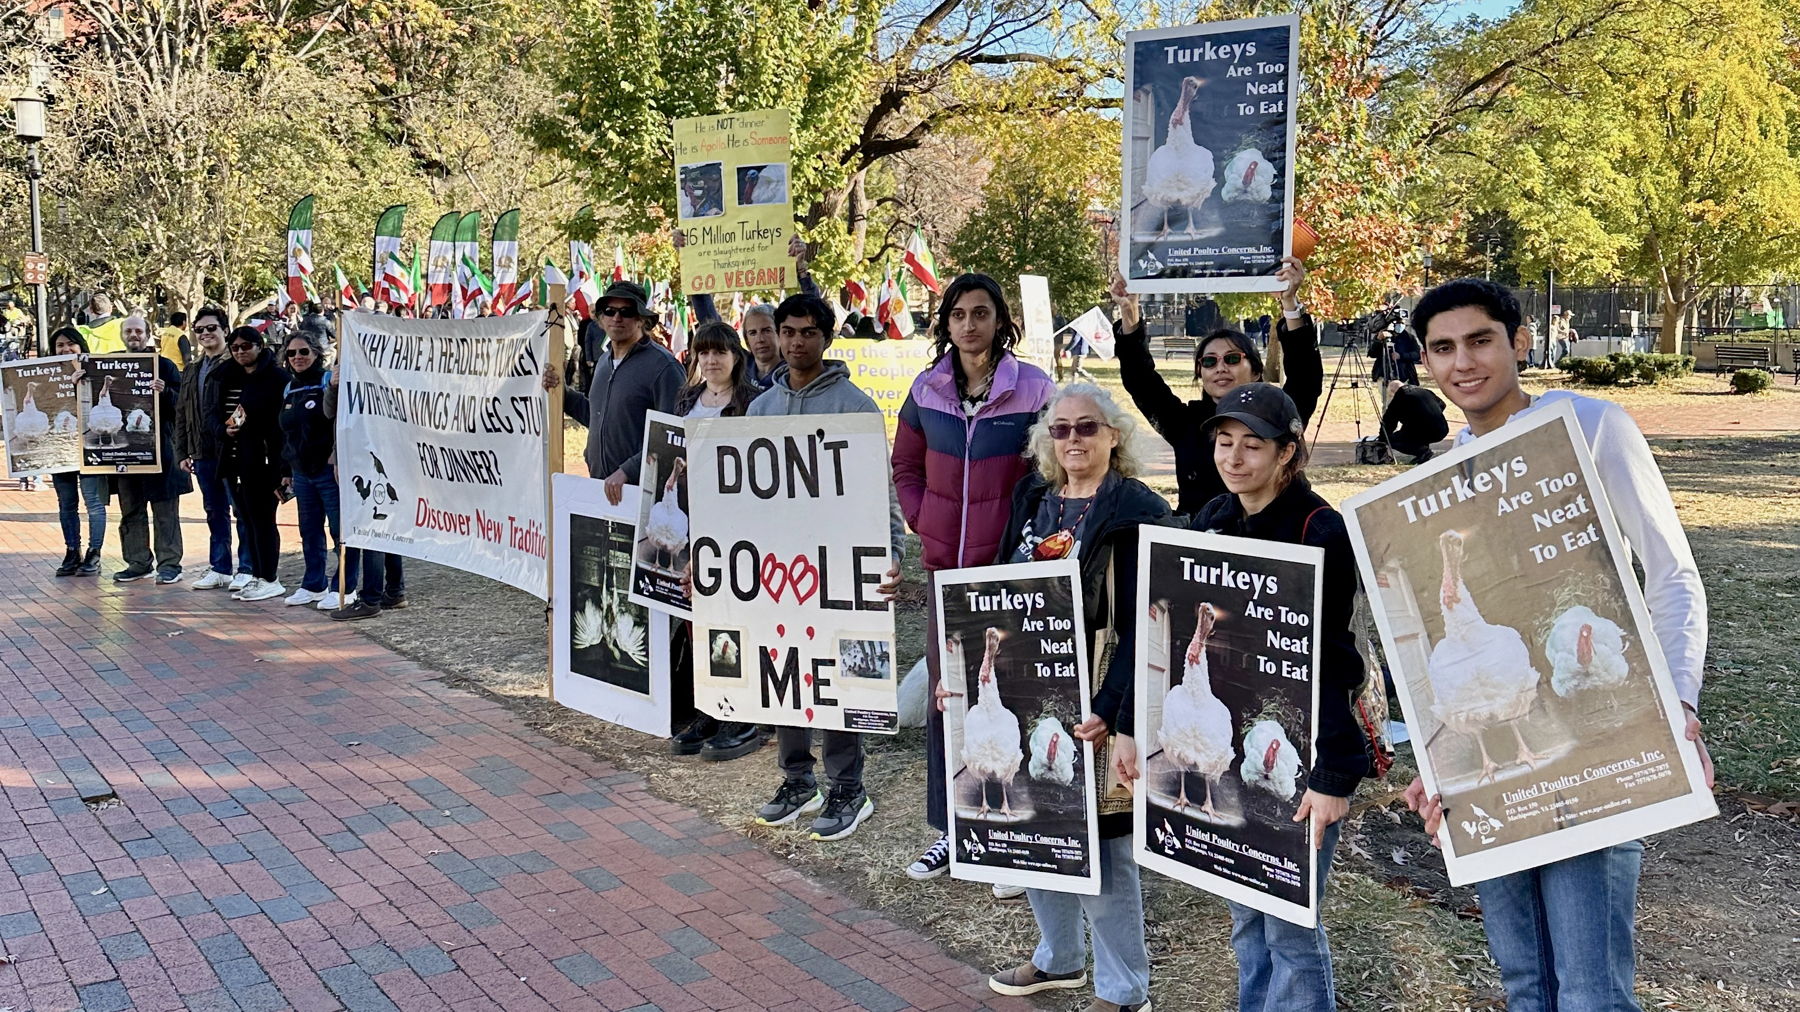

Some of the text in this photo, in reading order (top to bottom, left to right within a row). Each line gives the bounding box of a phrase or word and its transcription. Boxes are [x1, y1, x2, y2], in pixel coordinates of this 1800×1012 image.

[1164, 41, 1256, 64] Turkeys
[1226, 62, 1284, 78] Are Too
[1246, 80, 1284, 95] Neat
[1237, 100, 1283, 116] To Eat
[696, 122, 706, 133] He
[717, 118, 735, 130] NOT
[675, 142, 687, 156] He
[692, 145, 698, 153] is
[727, 134, 740, 149] He
[743, 139, 749, 147] is
[750, 131, 787, 145] Someone
[702, 225, 735, 245] Million
[737, 220, 782, 245] Turkeys
[698, 242, 769, 258] are slaughtered for
[1168, 248, 1191, 256] United
[1194, 247, 1220, 255] Poultry
[692, 267, 785, 291] GO VEGAN!
[358, 333, 539, 378] WHY HAVE A HEADLESS TURKEY
[828, 348, 856, 361] ing
[861, 345, 888, 358] the
[16, 366, 62, 378] Turkeys
[95, 361, 140, 372] Turkeys
[858, 364, 915, 380] People
[863, 387, 903, 400] Over
[347, 382, 385, 416] WITH
[409, 390, 450, 430] WINGS
[451, 395, 476, 433] AND
[480, 396, 514, 434] LEG
[417, 442, 502, 487] FOR DINNER?
[717, 429, 848, 499] DON'T
[1398, 456, 1528, 523] Turkeys
[1498, 472, 1578, 516] Are Too
[415, 498, 471, 536] Discover
[476, 508, 503, 544] New
[1532, 494, 1590, 532] Neat
[1530, 523, 1600, 564] To Eat
[692, 536, 889, 611] GOBBLE
[1180, 557, 1278, 600] Turkeys
[967, 588, 1045, 616] Turkeys
[1245, 601, 1309, 627] Are Too
[1022, 617, 1071, 632] Are Too
[1041, 638, 1073, 654] Neat
[1267, 630, 1309, 654] Neat
[759, 646, 838, 710] ME
[1035, 662, 1075, 677] To Eat
[1257, 655, 1309, 681] To Eat
[1502, 749, 1665, 805] United Poultry Concerns, Inc.
[988, 829, 1009, 841] United
[1010, 831, 1033, 844] Poultry
[1068, 837, 1081, 847] Inc.
[1185, 825, 1210, 840] United
[1212, 833, 1240, 853] Poultry
[1284, 858, 1300, 873] Inc.
